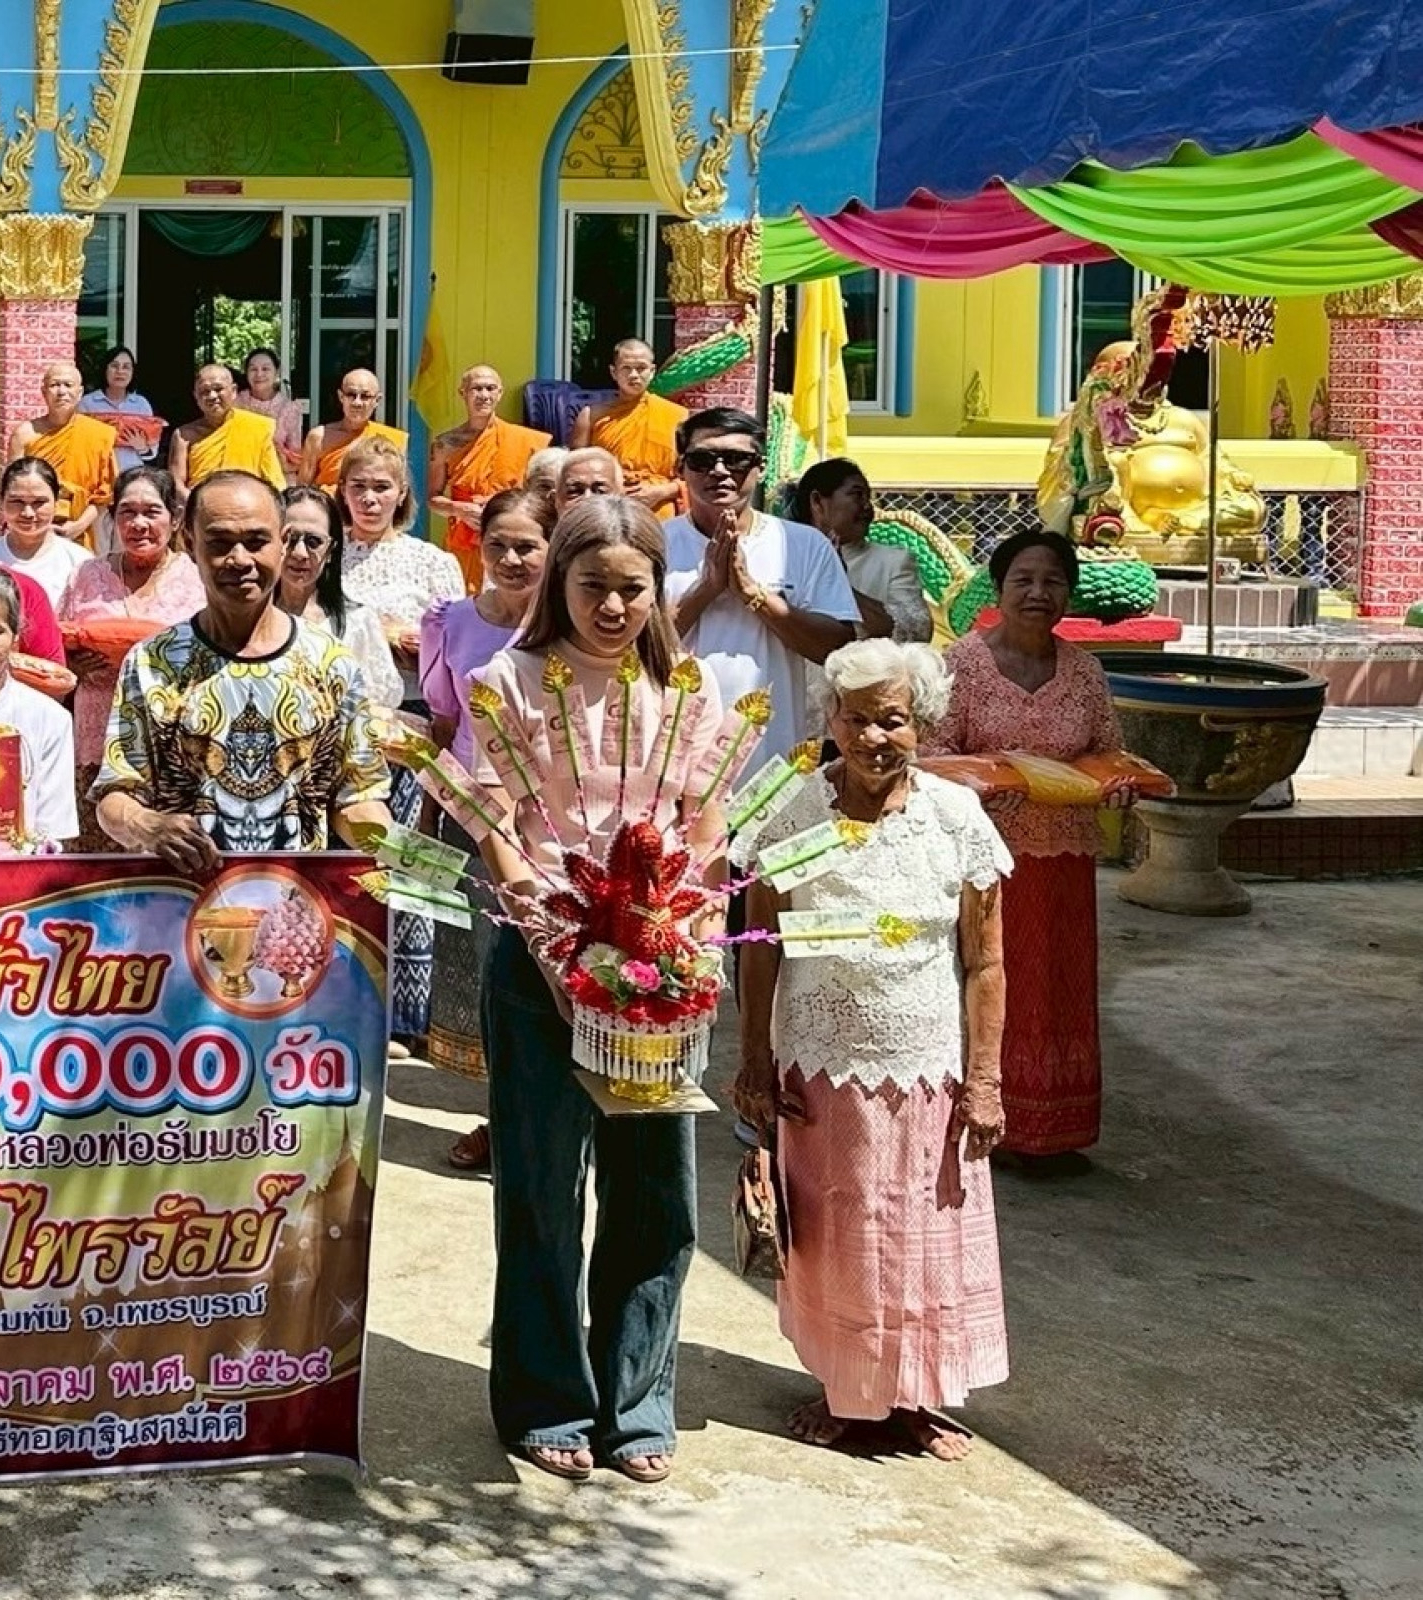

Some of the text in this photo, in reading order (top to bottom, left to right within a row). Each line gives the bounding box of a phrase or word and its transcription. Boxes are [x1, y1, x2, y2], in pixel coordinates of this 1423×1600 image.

[272, 1032, 346, 1092] วัด
[83, 1288, 266, 1326] จ.เพชรบูรณ์
[111, 1355, 194, 1394] พ.ศ.
[212, 1351, 331, 1385] ๒๕๖๘
